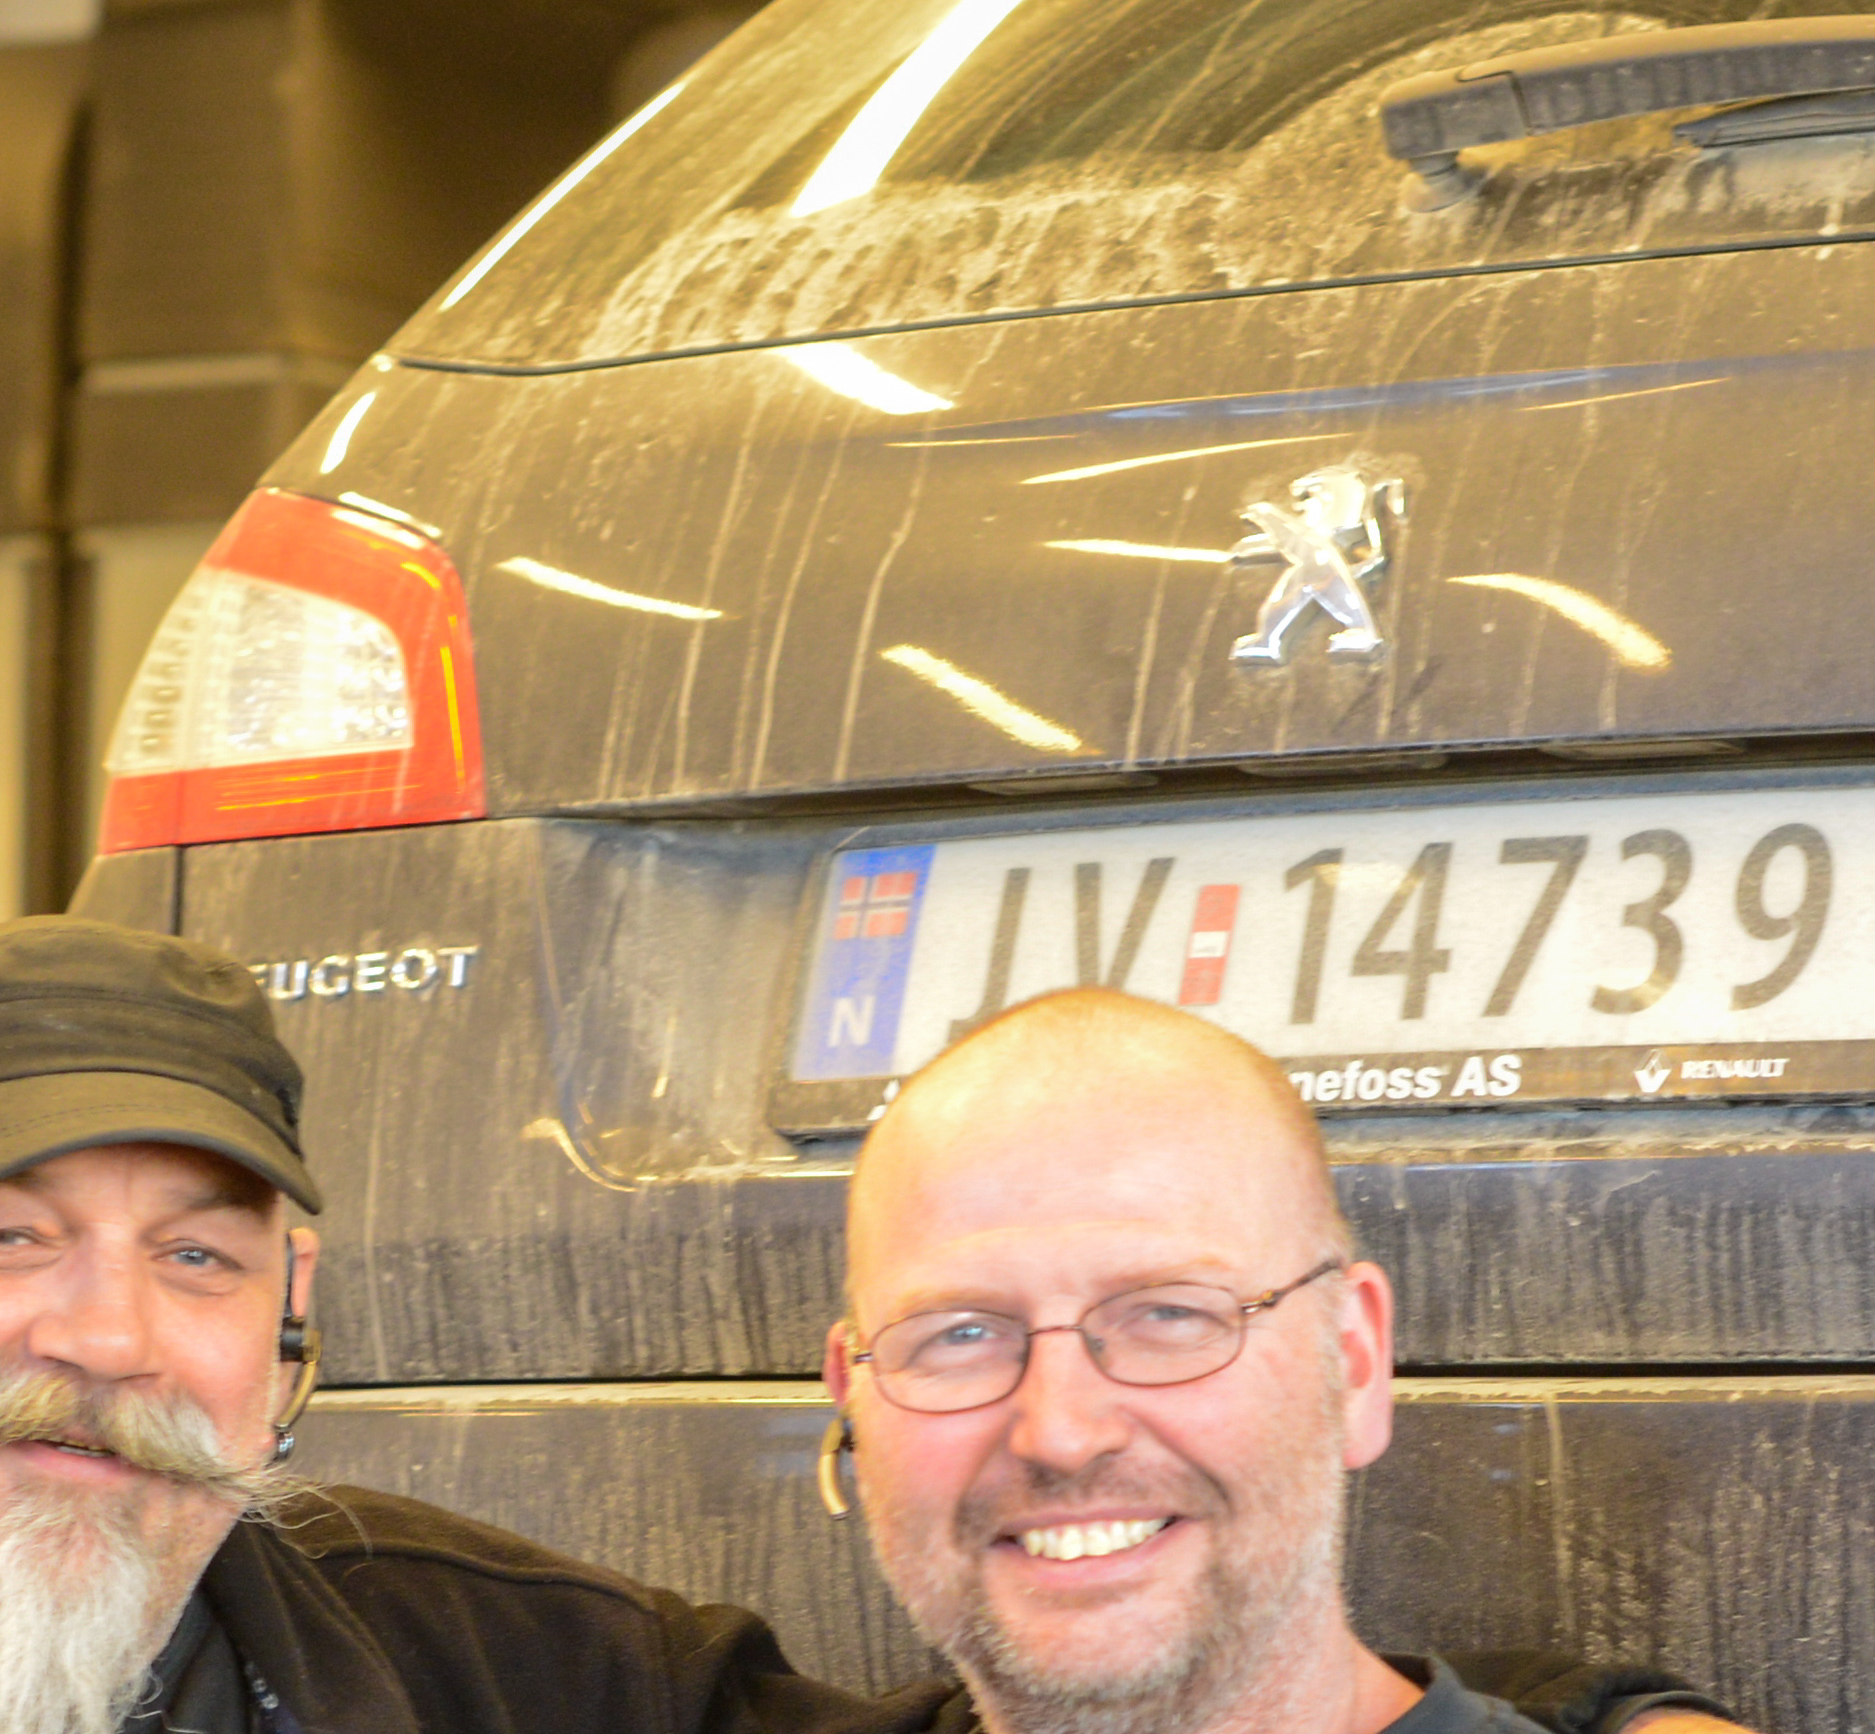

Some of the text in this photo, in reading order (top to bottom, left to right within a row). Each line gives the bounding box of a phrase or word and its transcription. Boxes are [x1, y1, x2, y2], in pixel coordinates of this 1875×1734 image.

[947, 822, 1834, 1045] JV 14739
[828, 996, 875, 1048] N
[1451, 1054, 1522, 1097] AS
[1680, 1058, 1790, 1080] RENAULT
